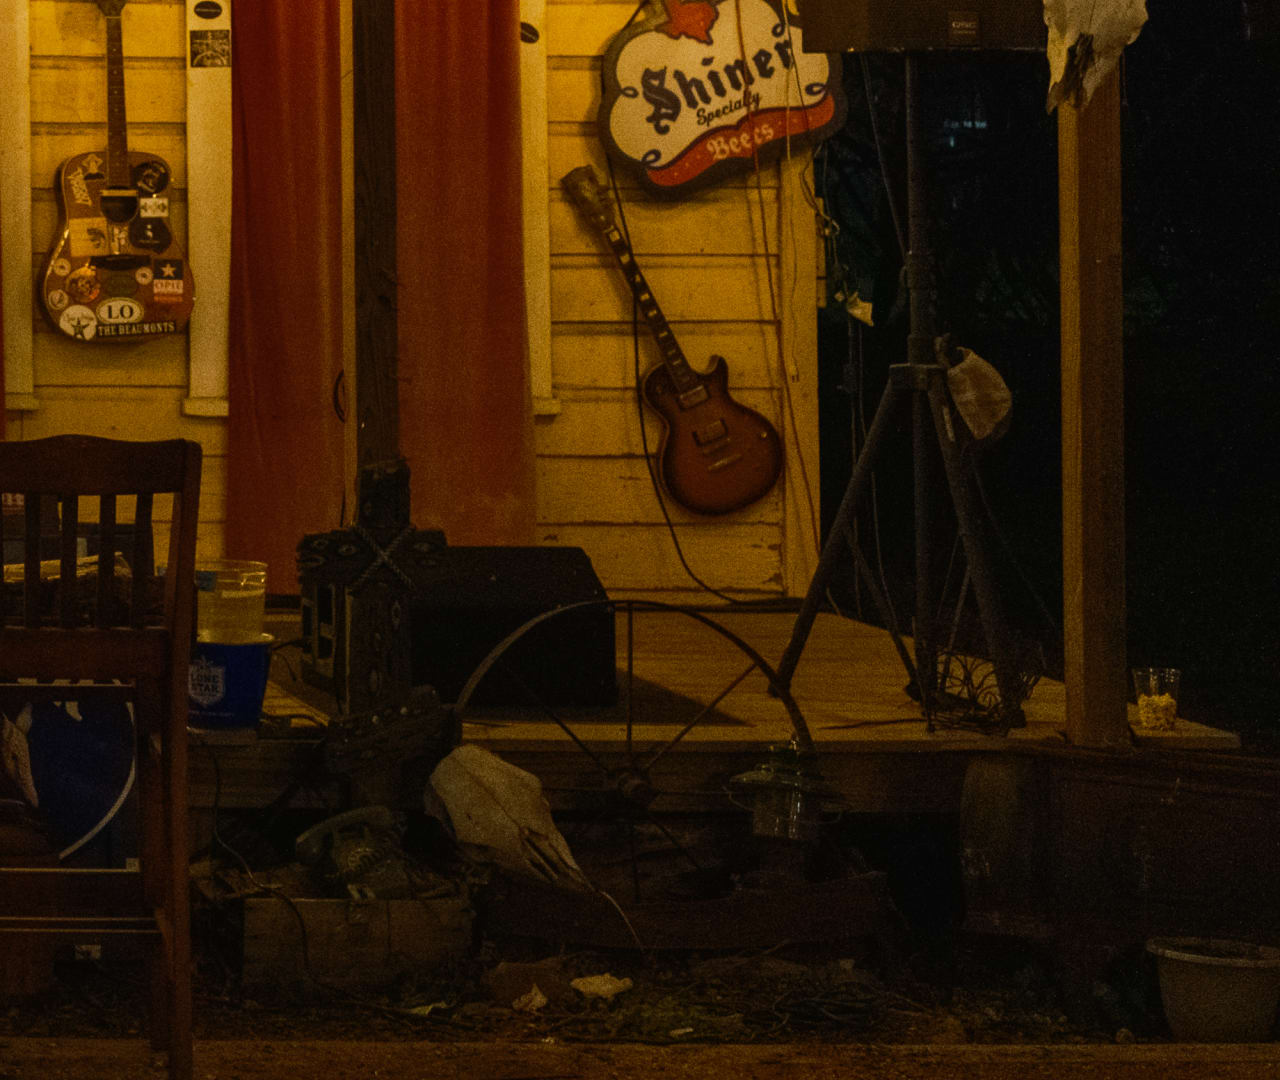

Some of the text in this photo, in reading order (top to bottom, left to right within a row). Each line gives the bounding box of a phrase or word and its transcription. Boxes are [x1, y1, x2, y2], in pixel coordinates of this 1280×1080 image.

[641, 39, 793, 135] Shiner
[696, 90, 761, 127] Specialty
[106, 304, 134, 320] LO
[98, 324, 117, 337] THE
